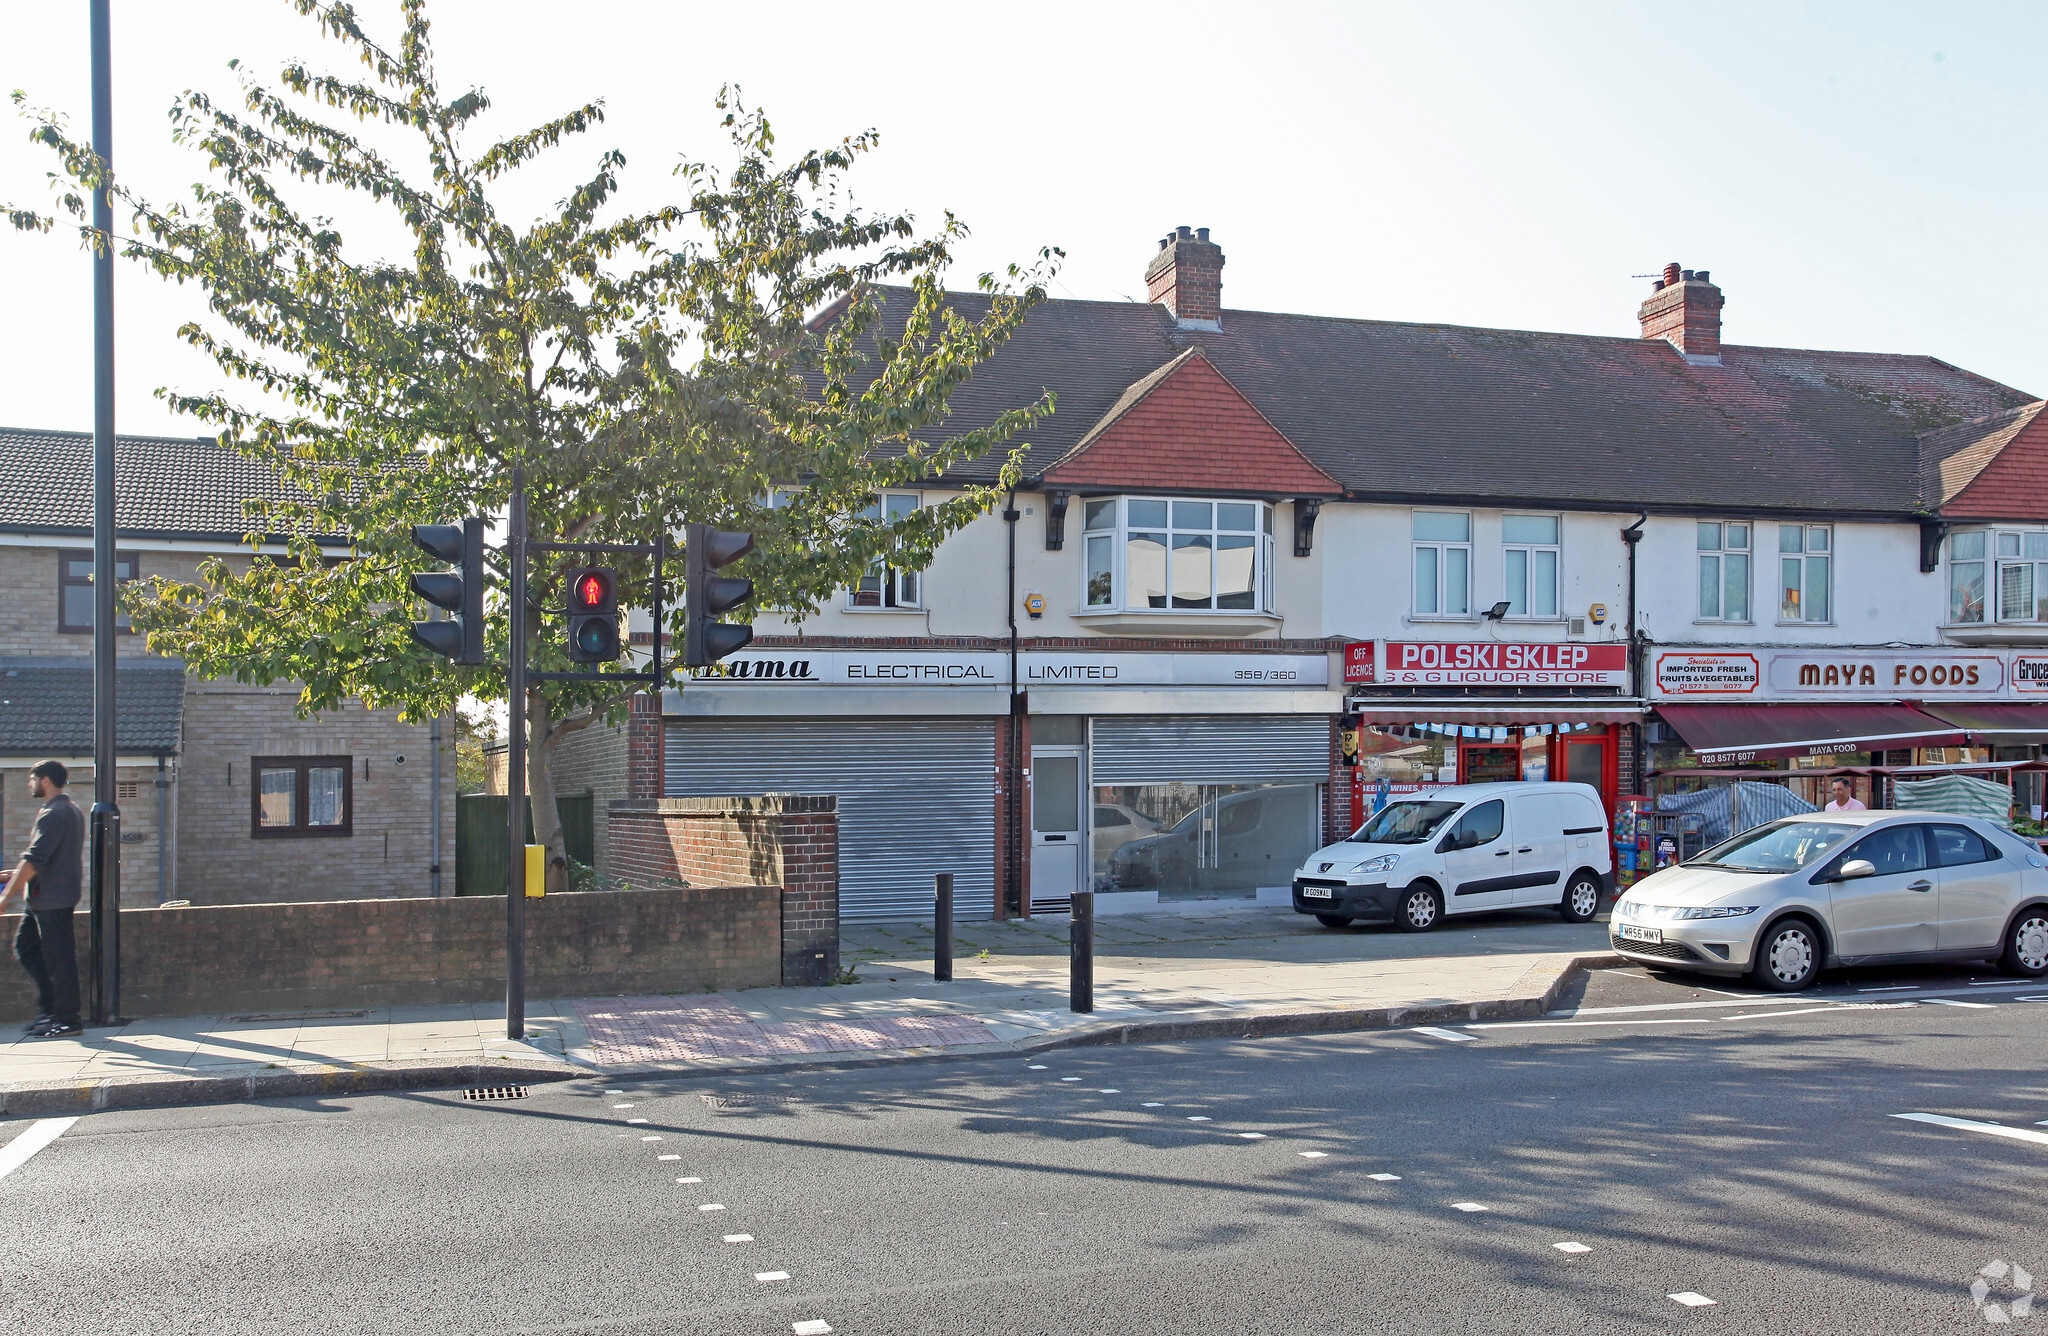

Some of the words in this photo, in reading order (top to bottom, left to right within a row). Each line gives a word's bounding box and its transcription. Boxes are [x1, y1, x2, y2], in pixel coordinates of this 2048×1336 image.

[1353, 647, 1366, 660] OFF
[1402, 645, 1499, 668] POLSKI
[1505, 645, 1589, 669] SKLEP
[700, 660, 812, 678] ama
[847, 665, 994, 678] ELECTRICAL
[1028, 665, 1118, 679] LIMITED
[1234, 670, 1297, 680] 358/360
[1346, 664, 1373, 677] LICENCE
[1799, 664, 1876, 686] MAYA
[1893, 664, 1980, 686] FOODS
[1402, 672, 1418, 682] &
[1425, 672, 1441, 682] G
[1447, 672, 1530, 683] LIQUOR
[1535, 672, 1608, 683] STORE
[1701, 754, 1716, 764] 020
[1717, 753, 1736, 762] 8577
[1737, 751, 1756, 760] 6077
[1809, 746, 1832, 756] MAYA
[1833, 743, 1857, 753] FOOD
